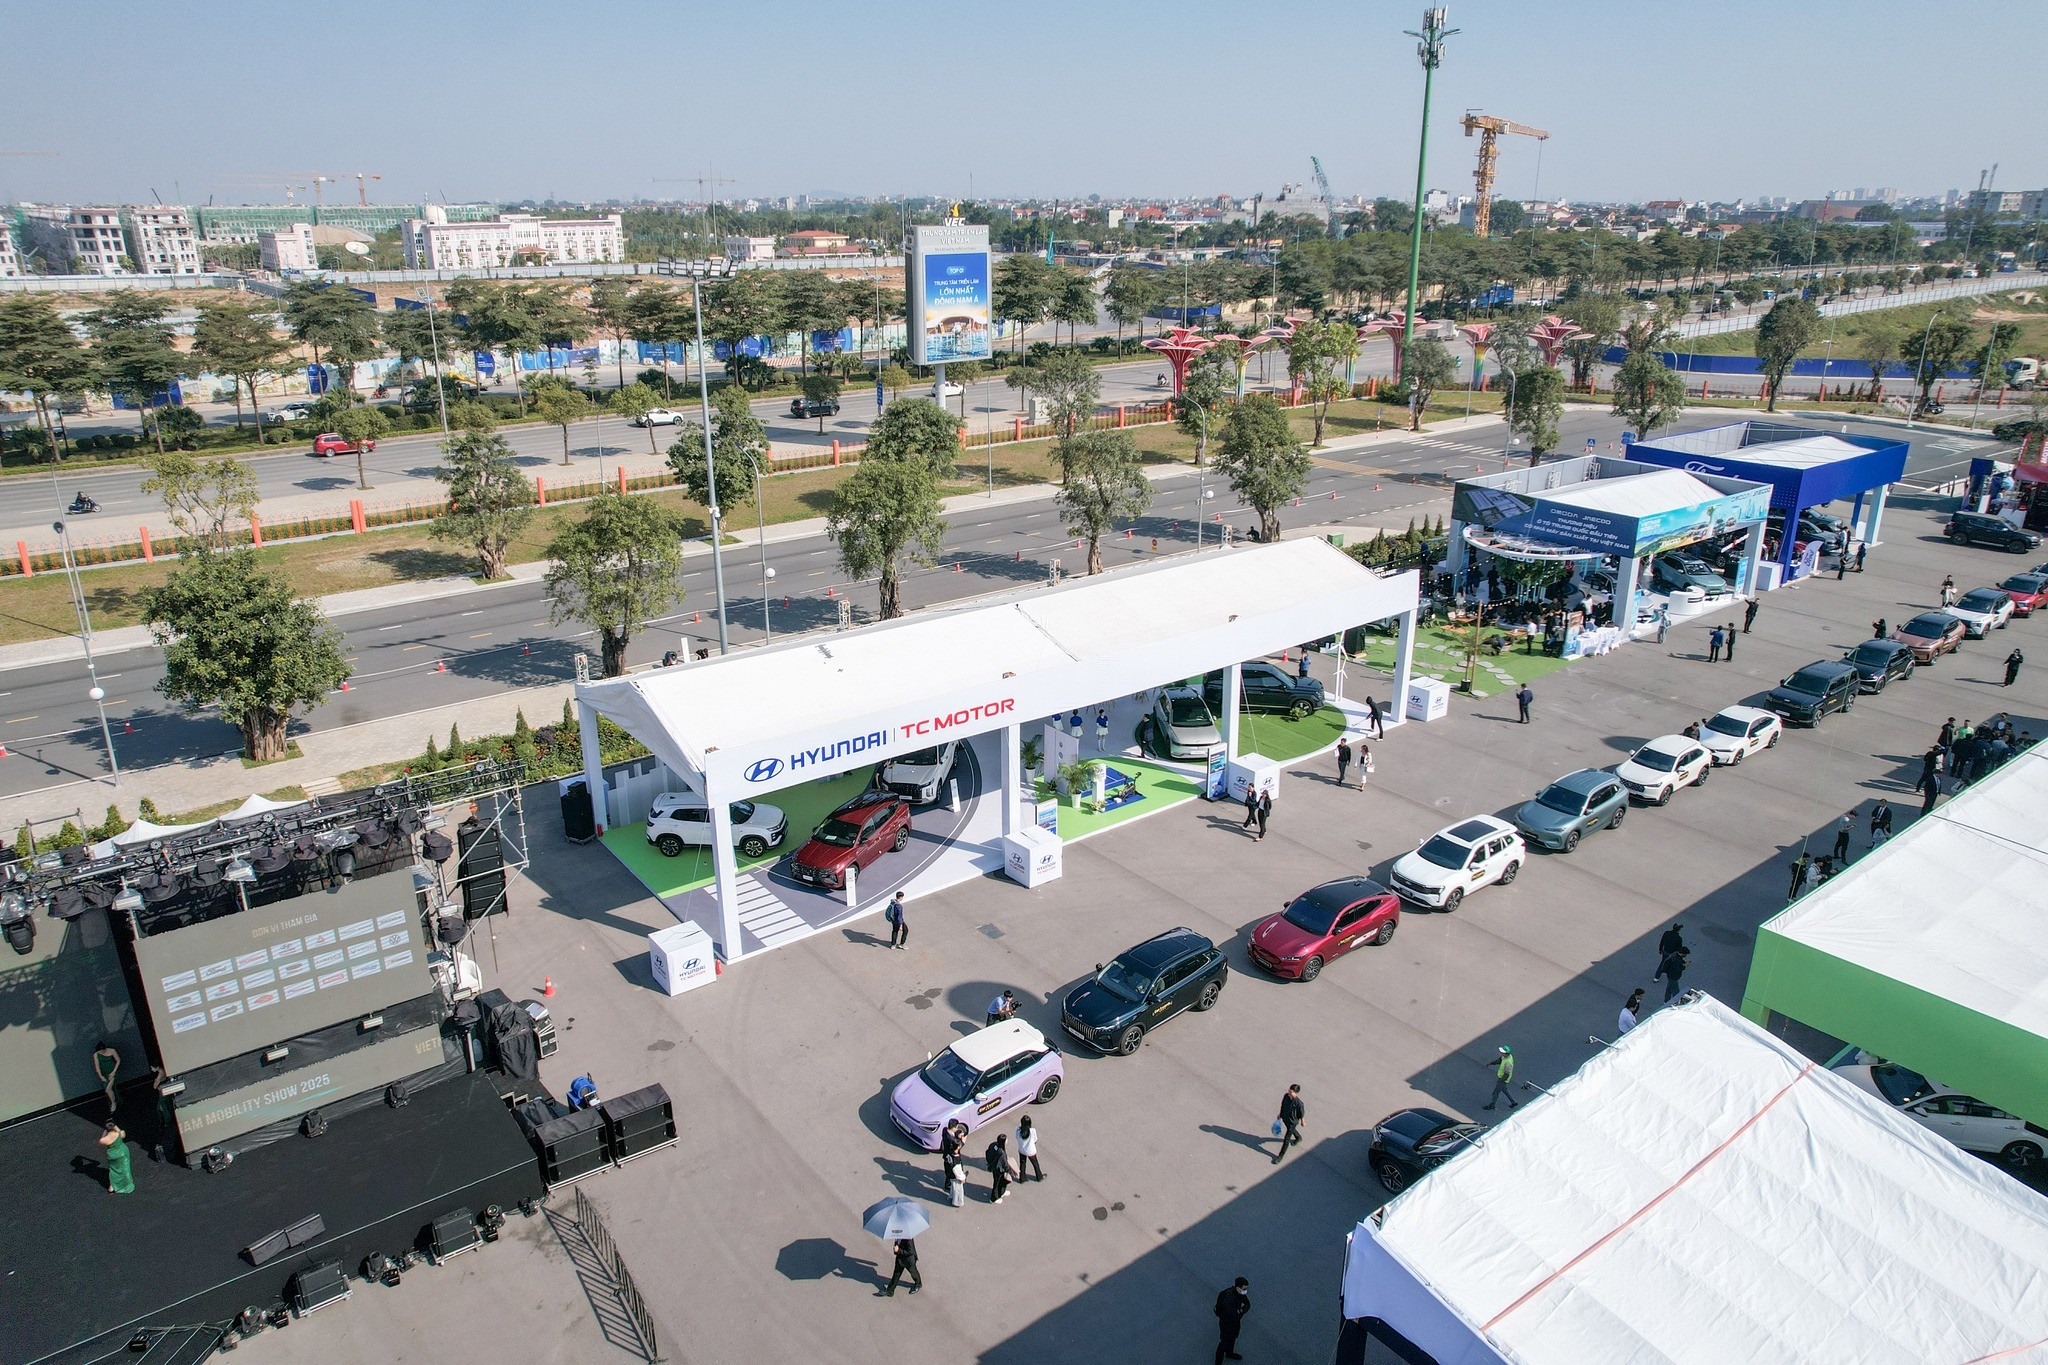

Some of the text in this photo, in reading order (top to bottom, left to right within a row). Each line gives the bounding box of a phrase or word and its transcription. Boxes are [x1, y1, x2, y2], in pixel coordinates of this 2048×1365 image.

[944, 217, 965, 227] VEC
[940, 285, 974, 295] LỚN NHẤT
[935, 297, 955, 305] ĐÔNG
[974, 295, 979, 303] Á
[1550, 509, 1611, 525] OMODA JAECOO
[1552, 522, 1572, 530] TRUNG
[791, 698, 1014, 770] HYUNDAI TC MOTOR
[280, 917, 303, 930] THAM
[304, 913, 318, 924] GIA
[680, 965, 706, 977] HYUNDAI
[205, 1097, 260, 1125] MOBILITY
[264, 1084, 298, 1104] SHOW
[300, 1074, 331, 1093] 2025
